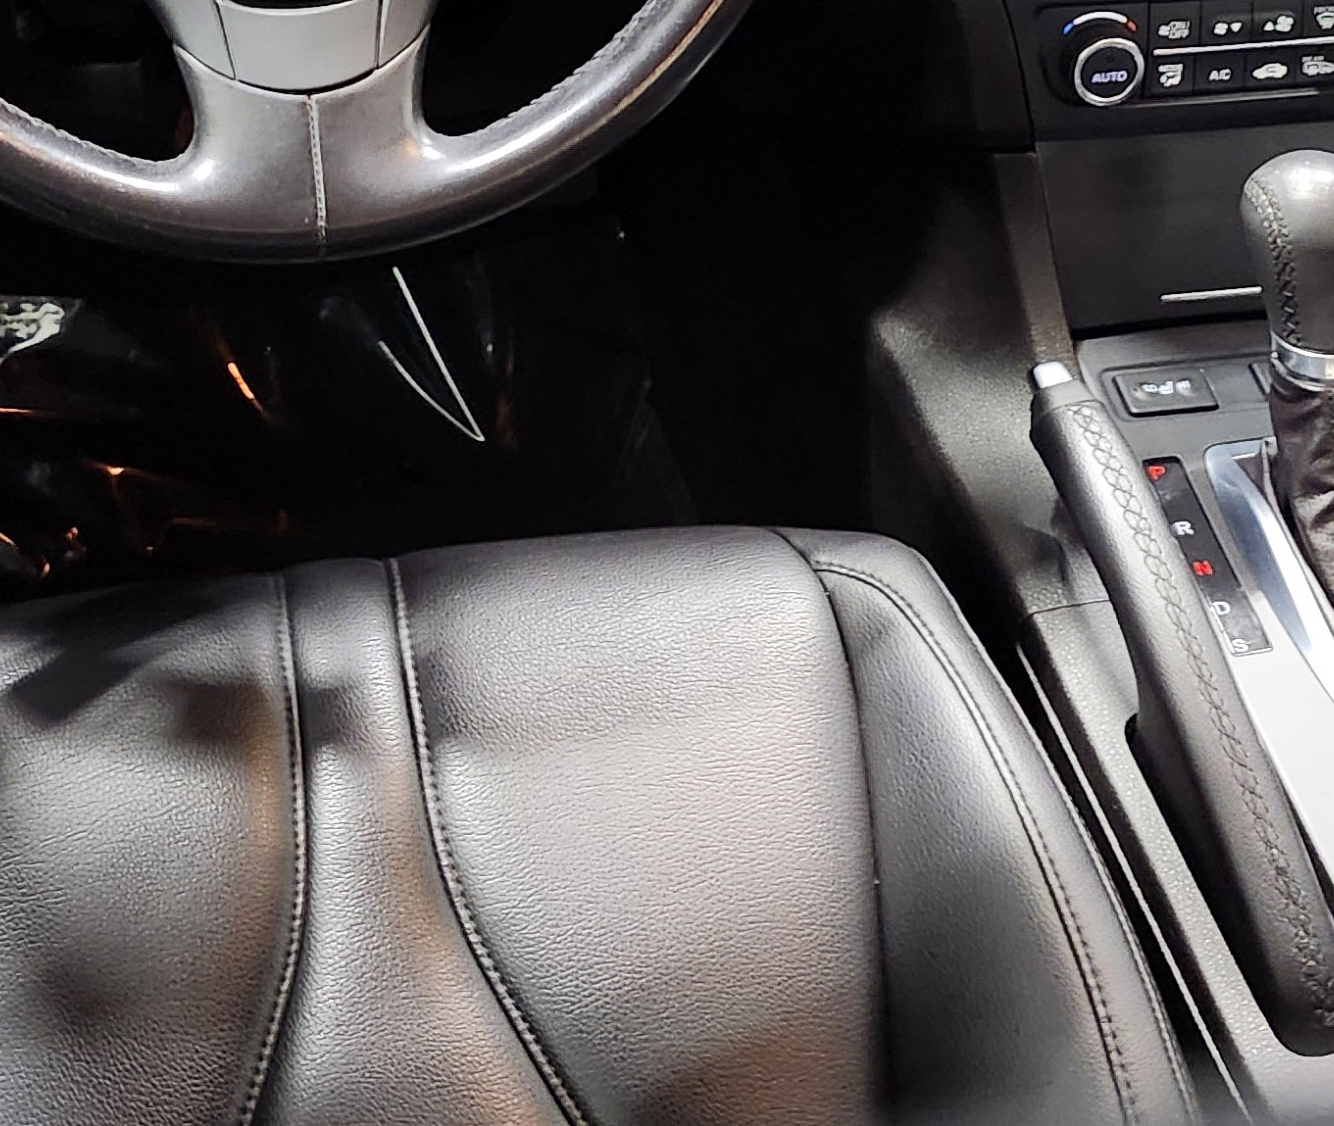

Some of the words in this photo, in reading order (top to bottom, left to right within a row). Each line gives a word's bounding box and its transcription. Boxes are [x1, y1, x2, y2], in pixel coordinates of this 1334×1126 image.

[1091, 69, 1128, 84] AUTO
[1148, 465, 1165, 480] P
[1172, 520, 1194, 536] R
[1192, 560, 1213, 576] N
[1212, 601, 1231, 616] D
[1233, 638, 1250, 653] S
